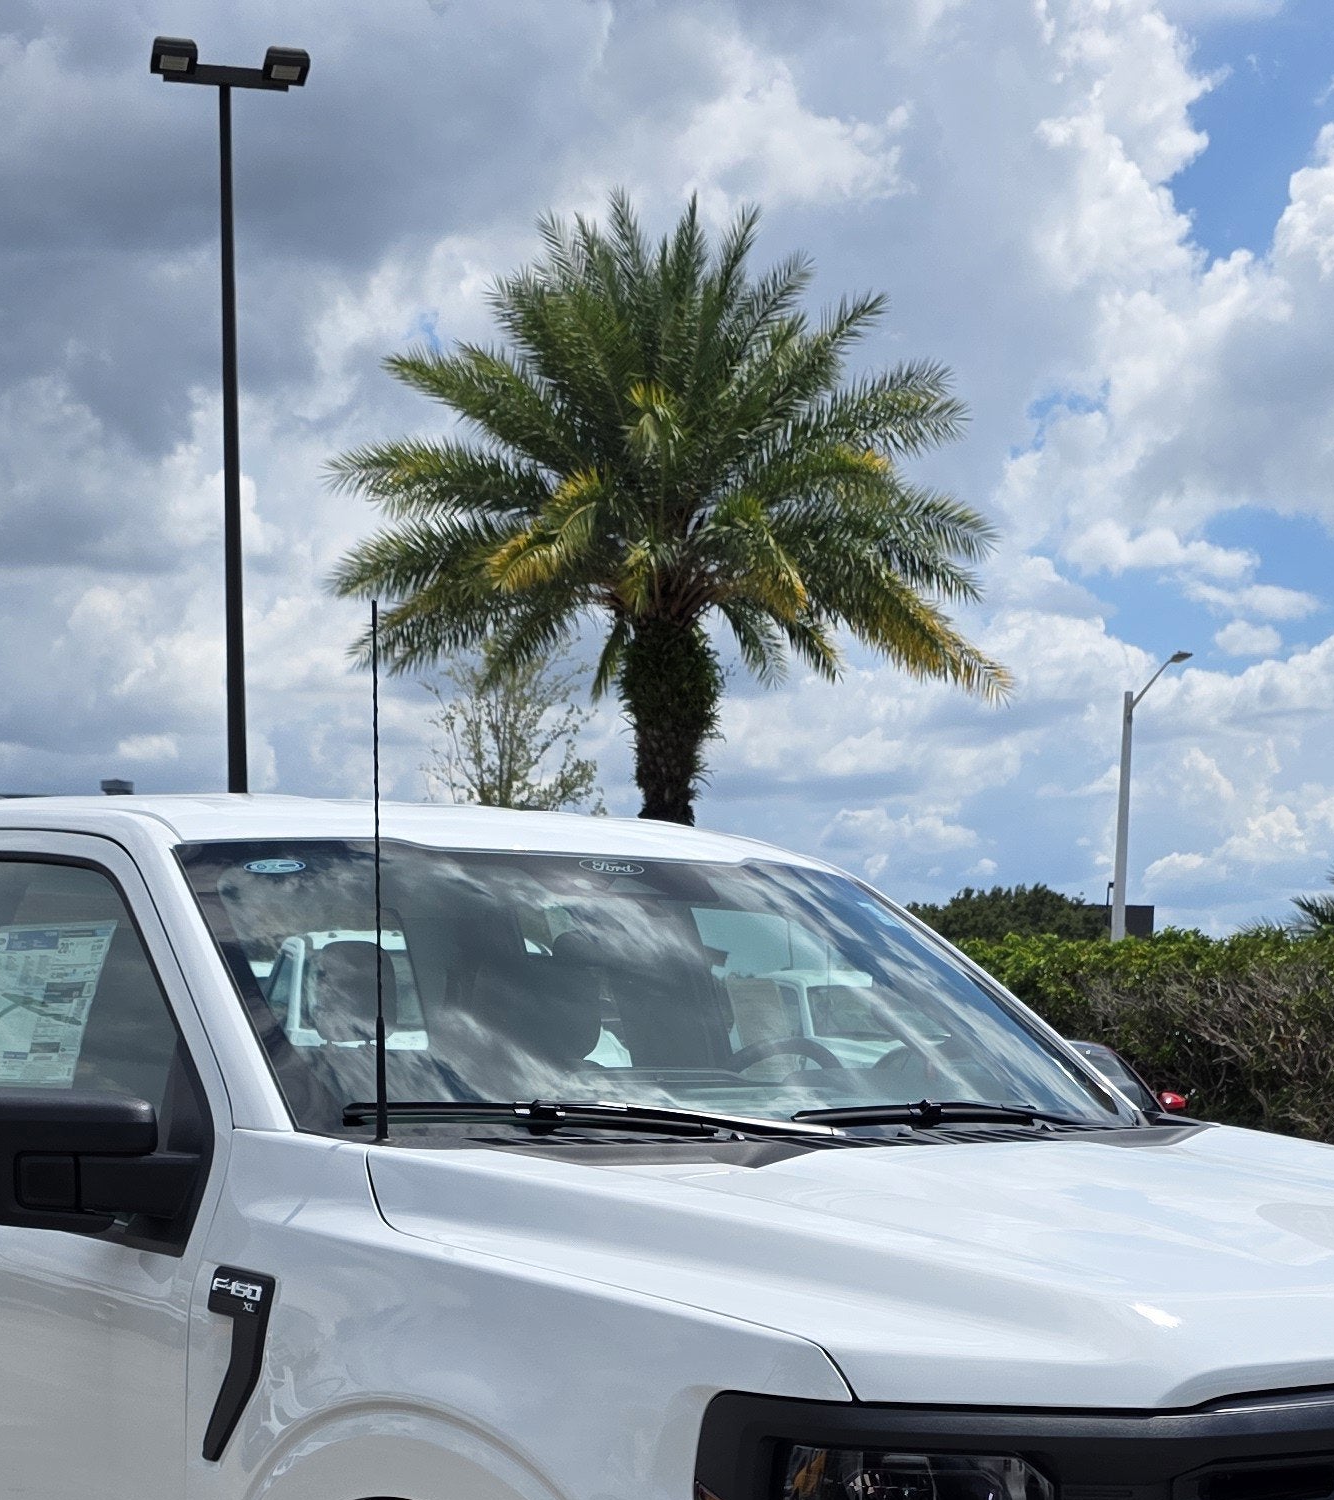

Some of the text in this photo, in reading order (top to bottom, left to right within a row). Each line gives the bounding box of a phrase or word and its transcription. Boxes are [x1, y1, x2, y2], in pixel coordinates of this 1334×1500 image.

[592, 860, 635, 873] Ford
[211, 1276, 263, 1302] F-150
[242, 1301, 255, 1313] XL
